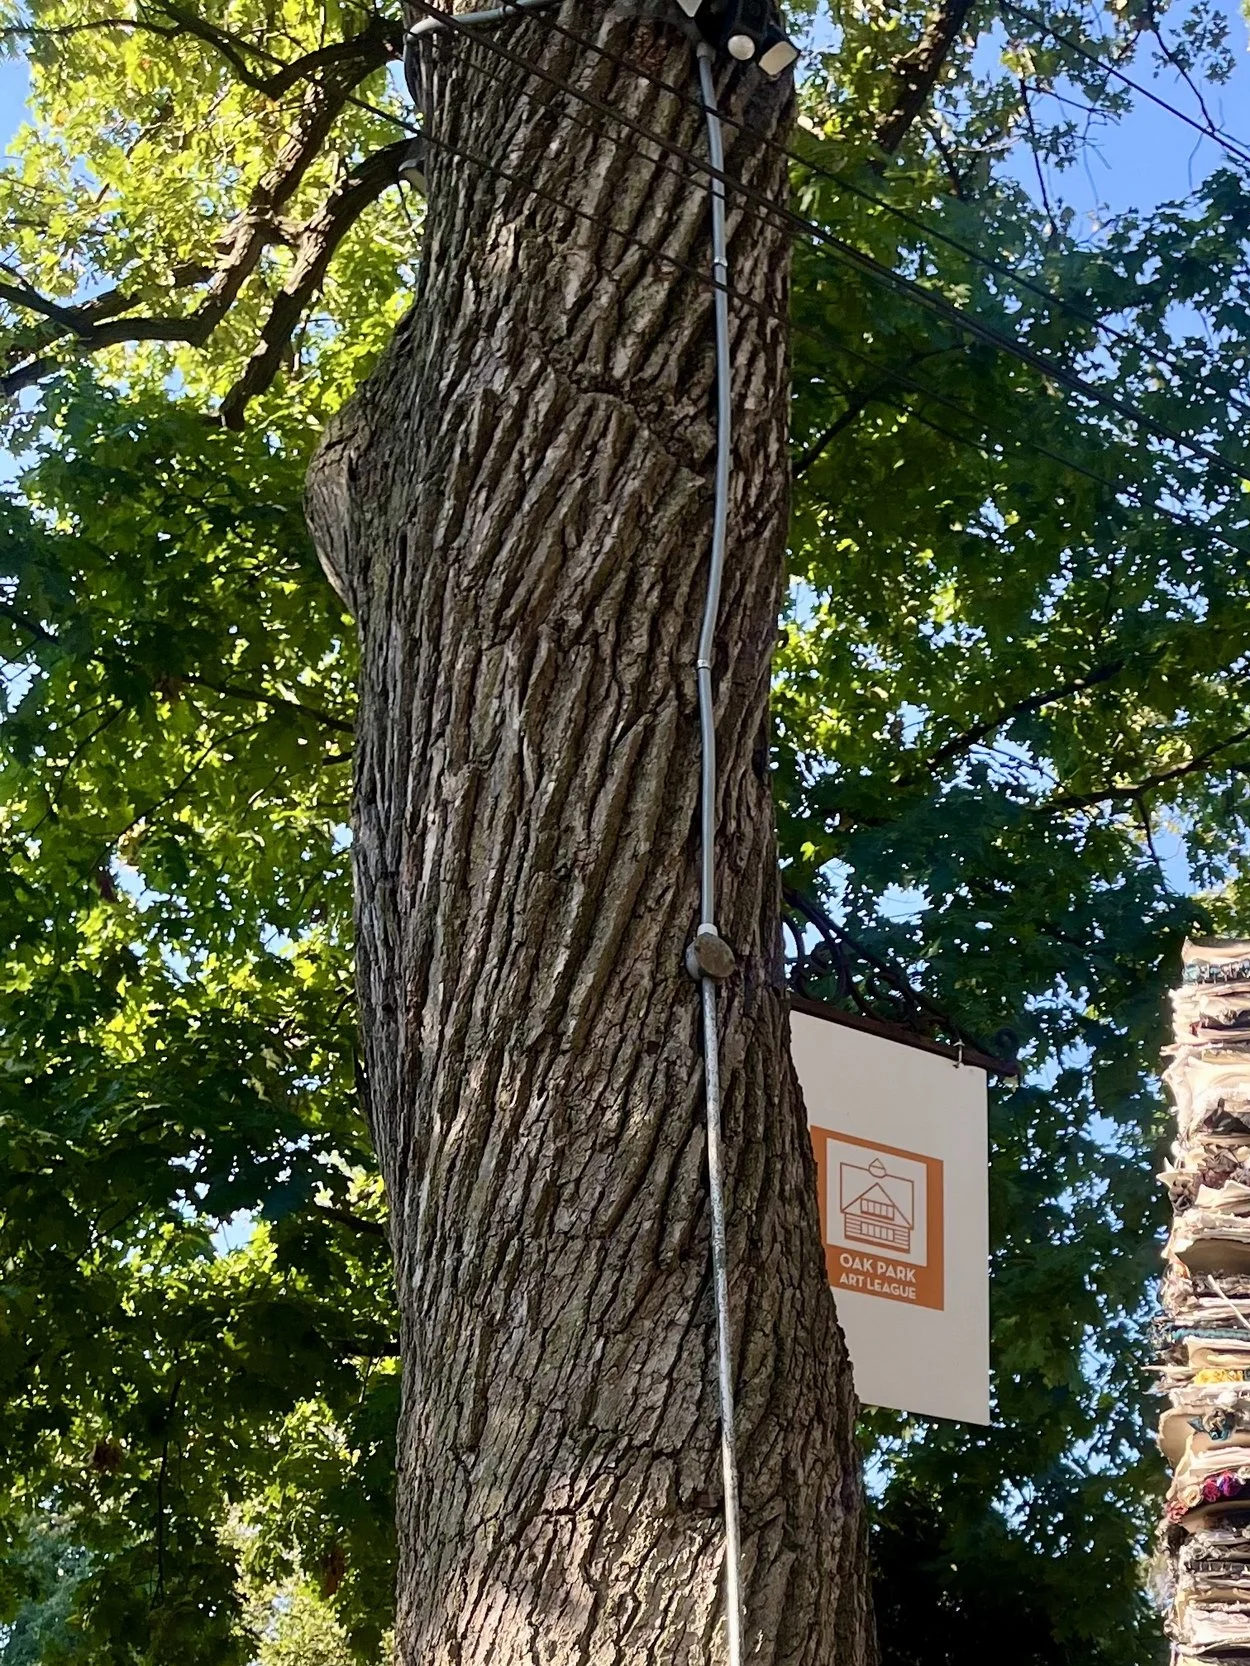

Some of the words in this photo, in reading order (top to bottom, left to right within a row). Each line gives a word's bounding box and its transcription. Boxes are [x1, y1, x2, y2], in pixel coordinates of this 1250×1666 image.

[840, 1253, 873, 1273] OAK
[877, 1261, 916, 1283] PARK
[840, 1272, 865, 1288] ART
[867, 1279, 917, 1299] LEAGUE
